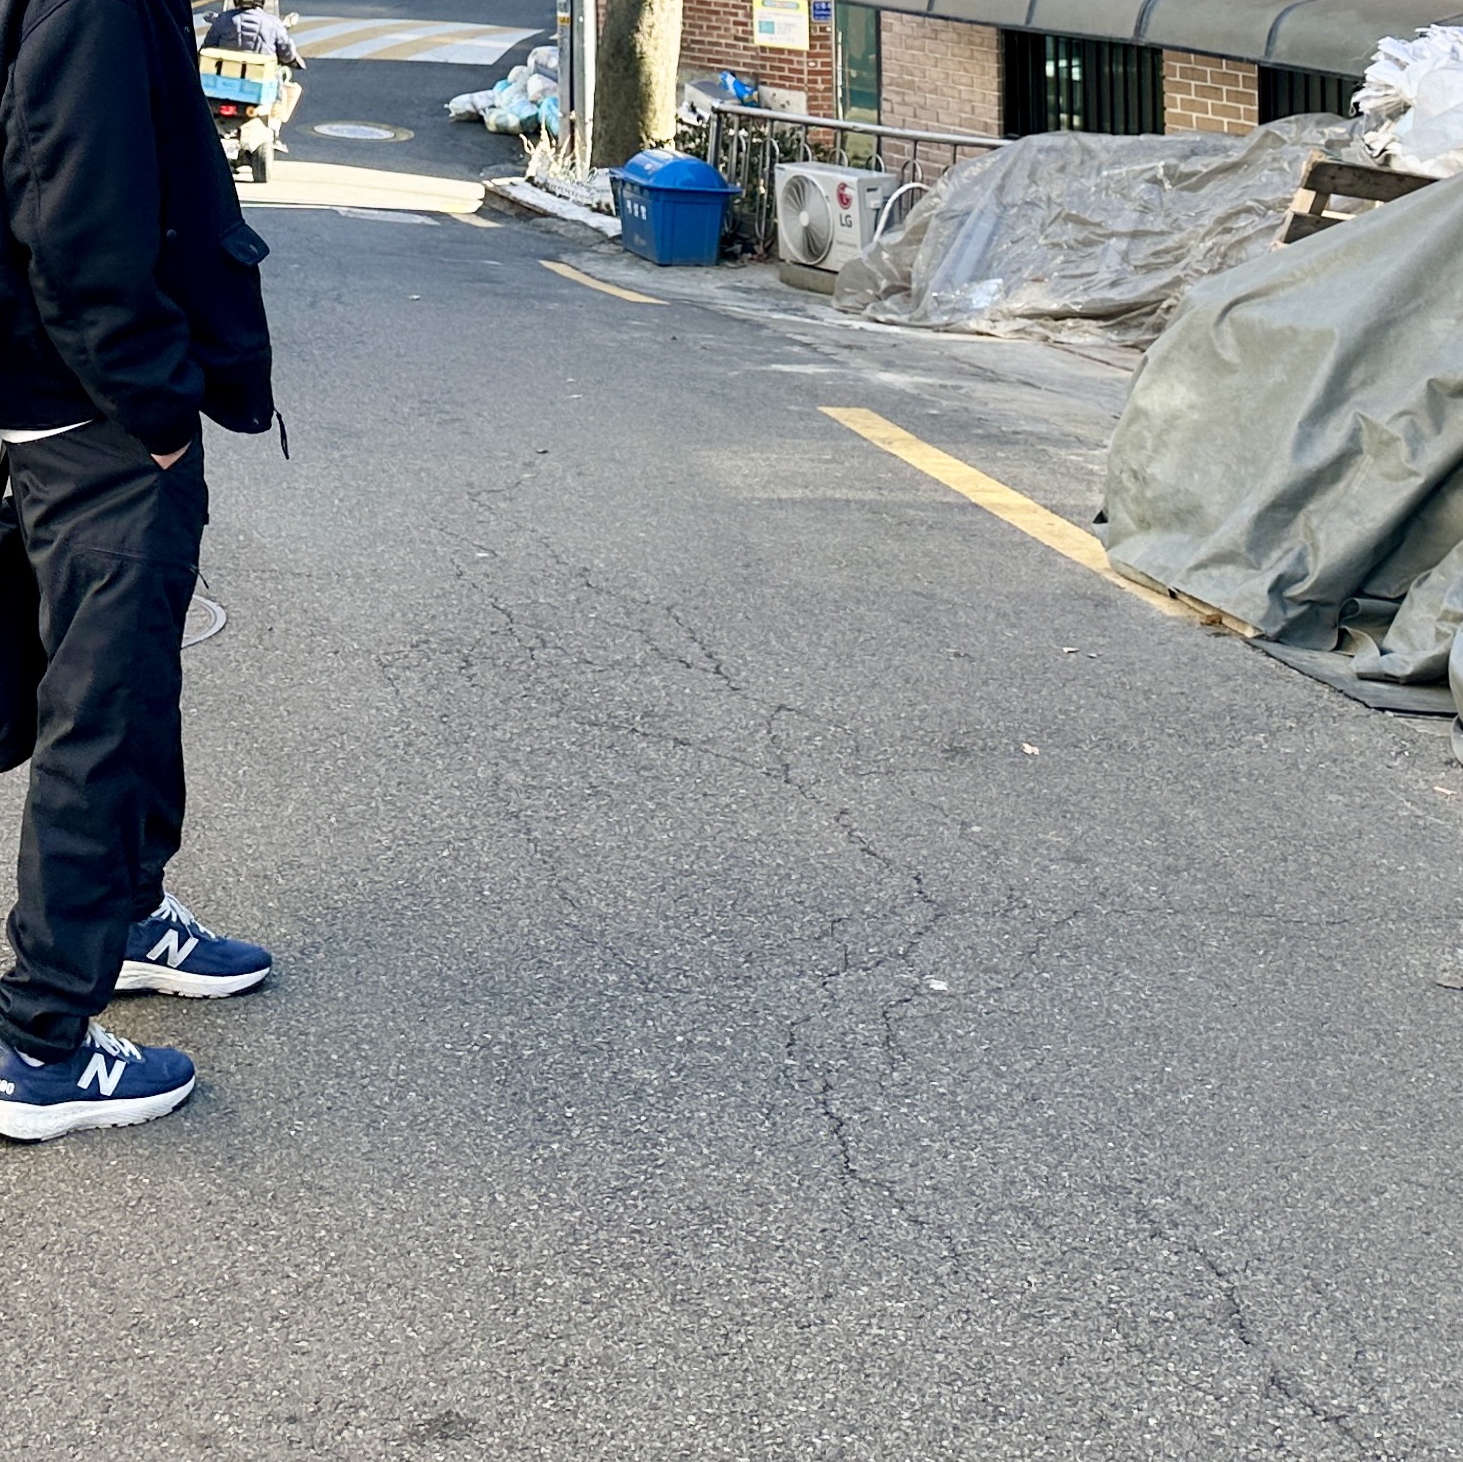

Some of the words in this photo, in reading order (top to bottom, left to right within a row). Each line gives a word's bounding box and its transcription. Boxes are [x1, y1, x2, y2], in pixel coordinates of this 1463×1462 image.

[839, 214, 853, 228] LG
[146, 928, 199, 968] N
[77, 1052, 127, 1096] N
